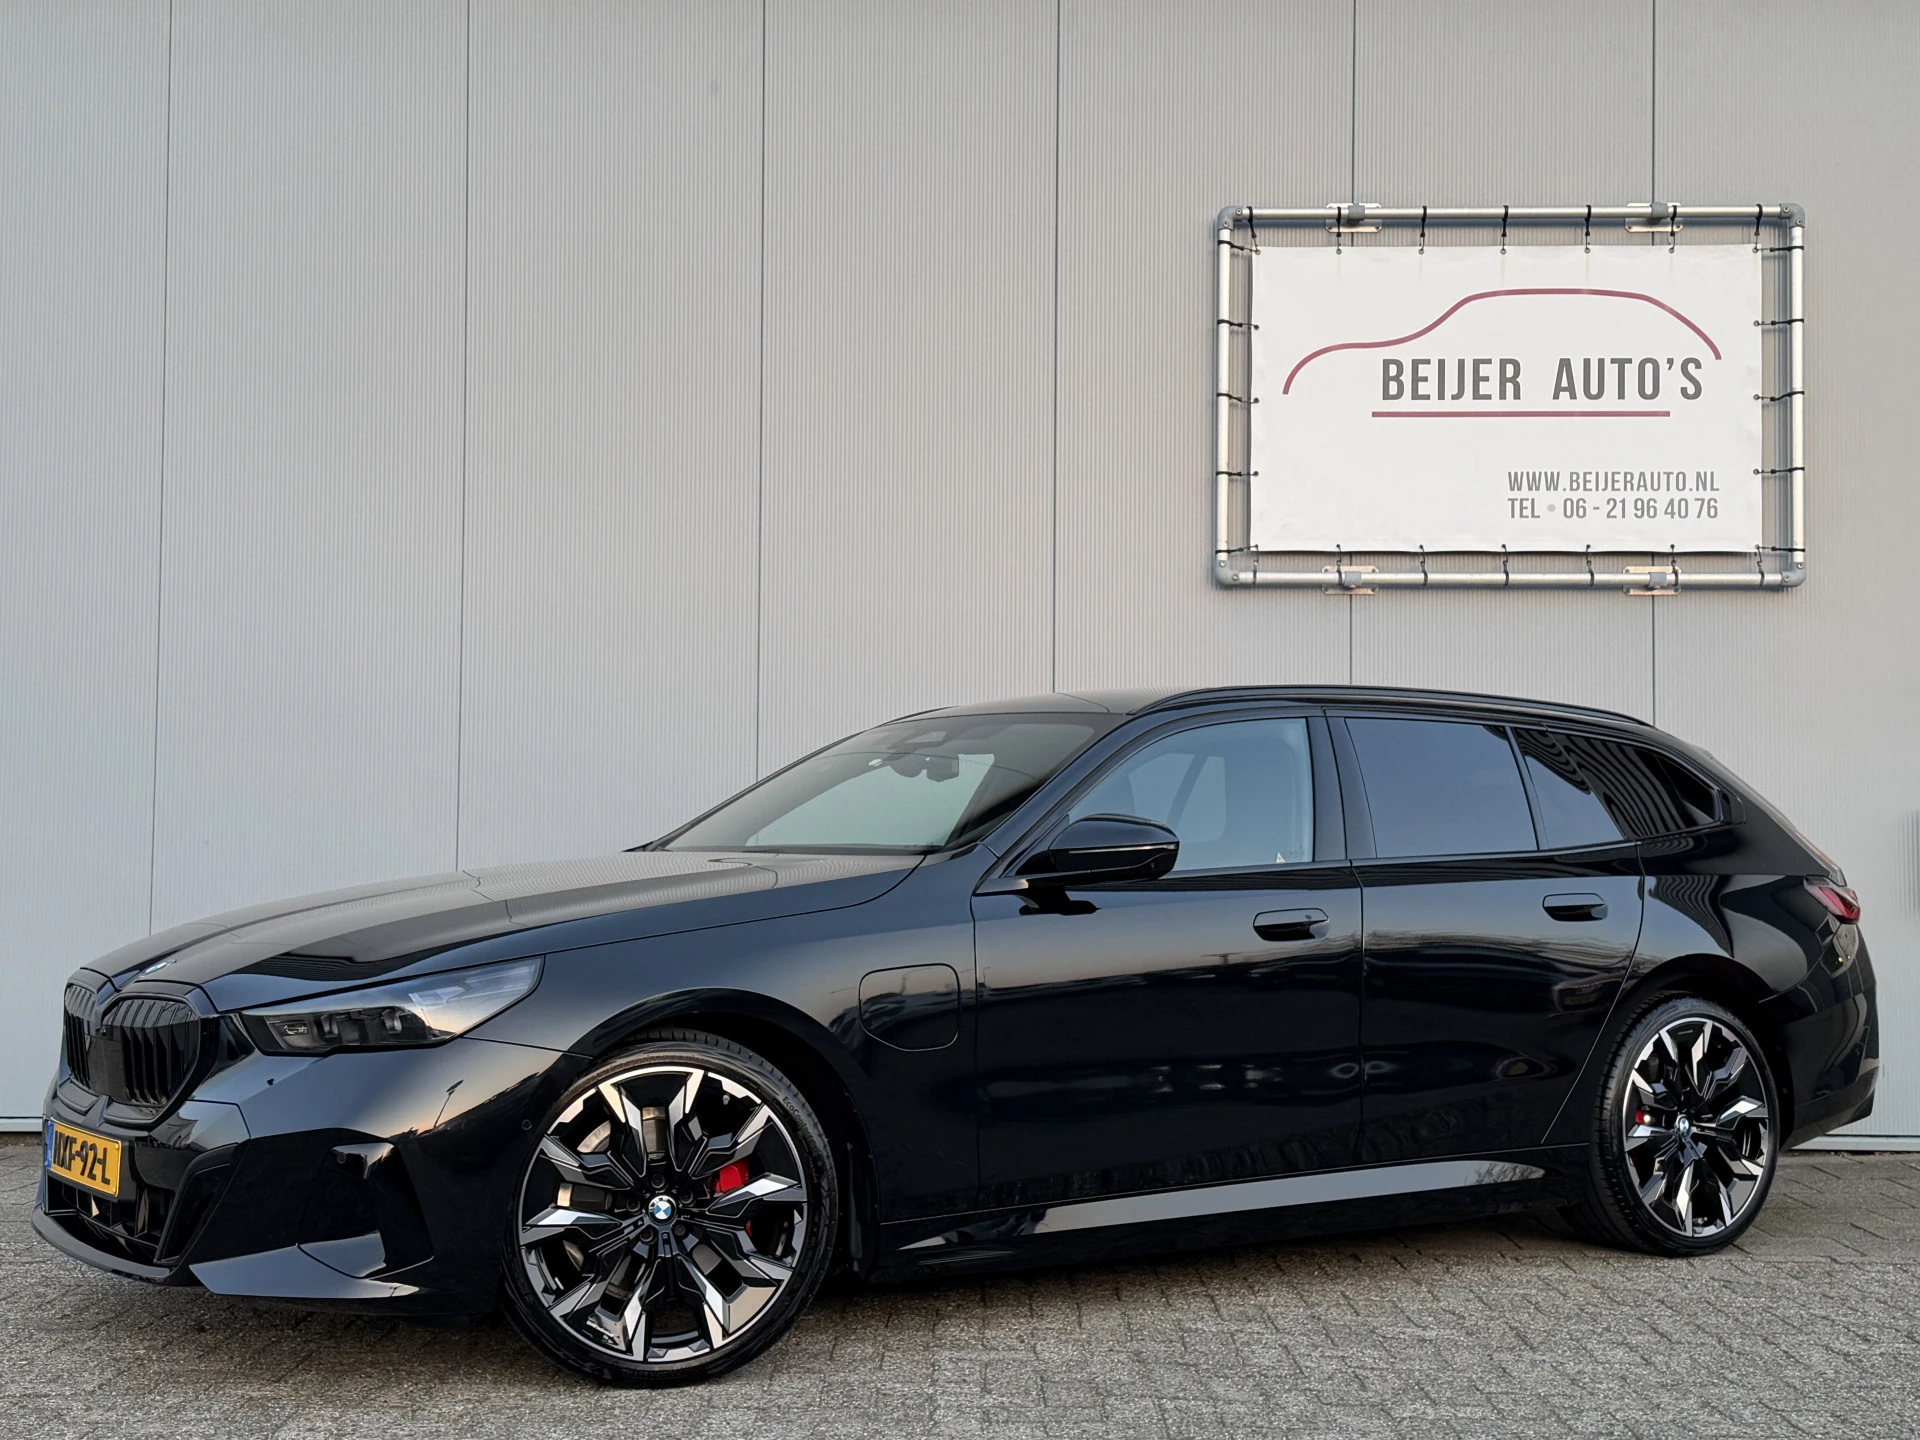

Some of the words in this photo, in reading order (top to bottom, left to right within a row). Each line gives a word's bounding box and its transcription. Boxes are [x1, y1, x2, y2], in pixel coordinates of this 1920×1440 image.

[1382, 358, 1522, 401] BEIJER
[1552, 356, 1703, 401] AUTO'S
[1507, 470, 1720, 492] WWW.BEIJERAUTO.NL
[1507, 497, 1541, 519] TEL
[1563, 497, 1587, 519] 06
[1606, 497, 1626, 519] 21
[1633, 497, 1658, 519] 96
[1664, 497, 1689, 519] 40
[1694, 497, 1718, 519] 76
